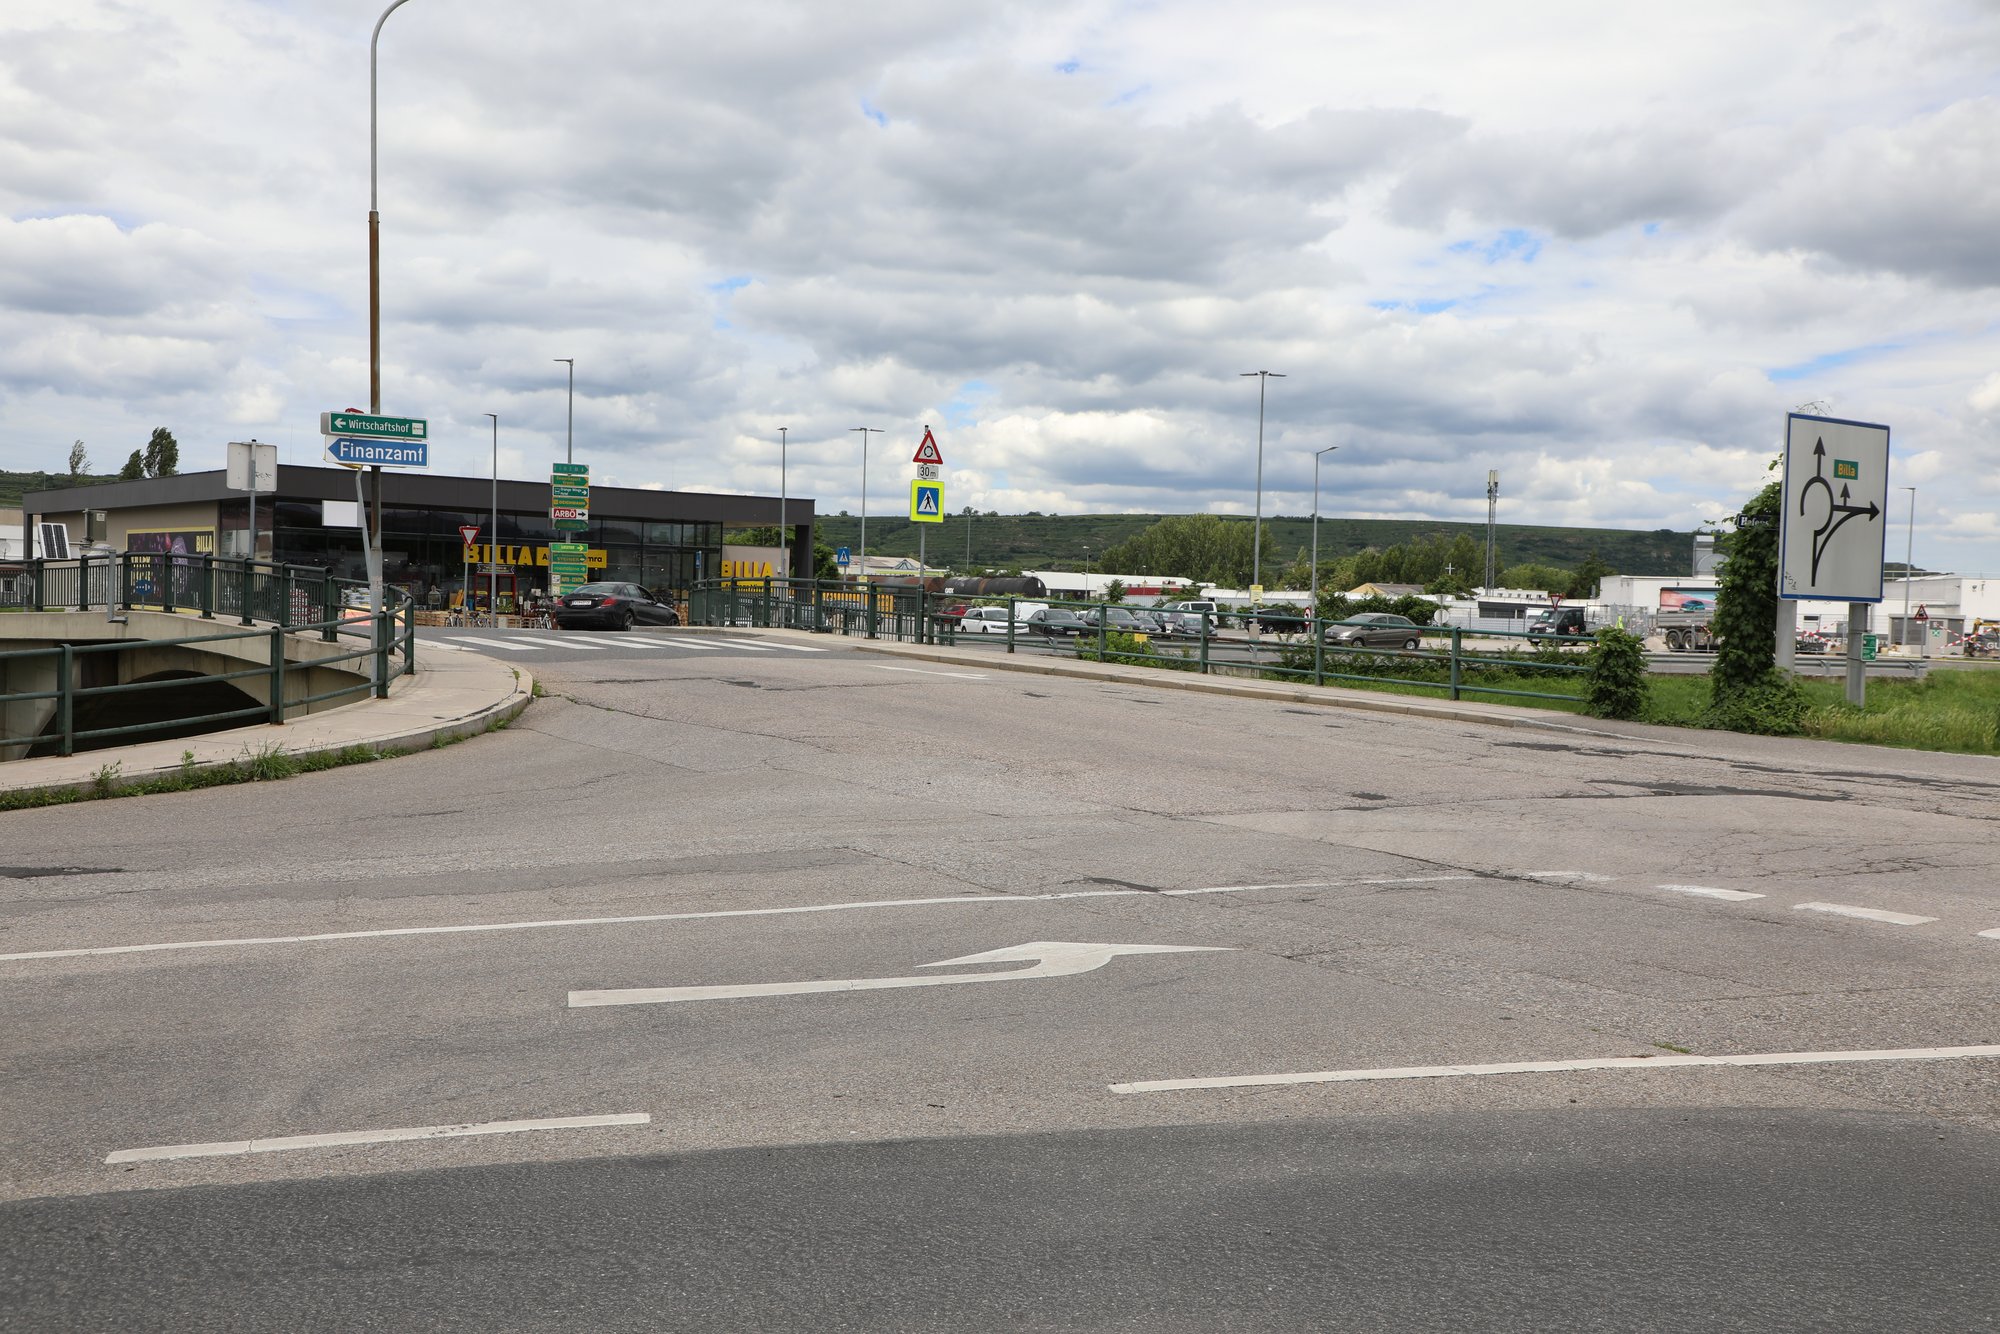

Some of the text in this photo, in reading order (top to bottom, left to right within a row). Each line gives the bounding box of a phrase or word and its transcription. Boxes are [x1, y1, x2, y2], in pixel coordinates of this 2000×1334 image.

[348, 419, 410, 433] Wirtschaftshof
[340, 441, 423, 462] Finanzamt
[1838, 463, 1857, 477] Billa
[554, 509, 576, 518] ARBÖ
[195, 535, 213, 553] BILLA
[463, 543, 533, 566] BILLA
[721, 560, 774, 577] BILLA
